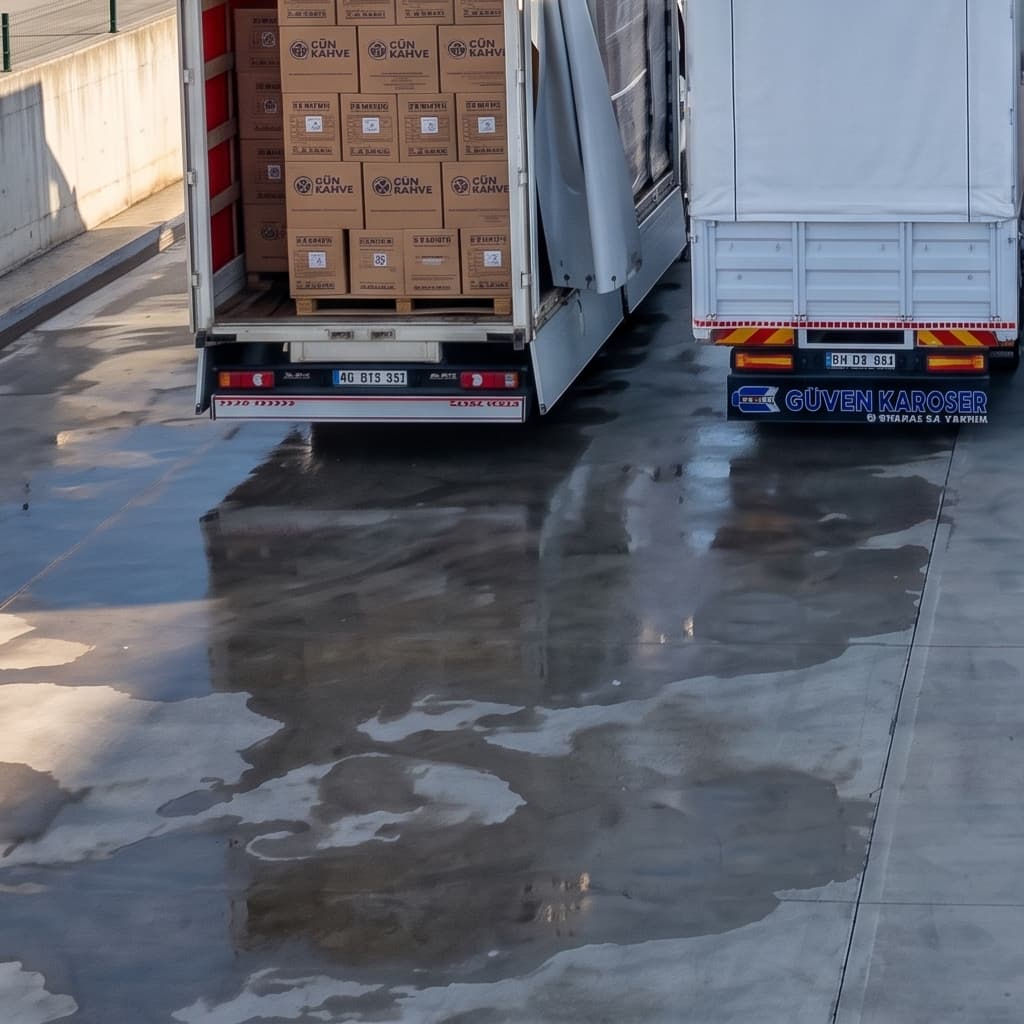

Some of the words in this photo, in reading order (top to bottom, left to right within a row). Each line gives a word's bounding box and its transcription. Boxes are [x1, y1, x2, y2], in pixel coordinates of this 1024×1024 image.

[311, 49, 351, 58] KAHVE
[389, 49, 430, 59] KAHVE
[785, 387, 873, 412] GÜVEN
[878, 390, 988, 413] KAROSER
